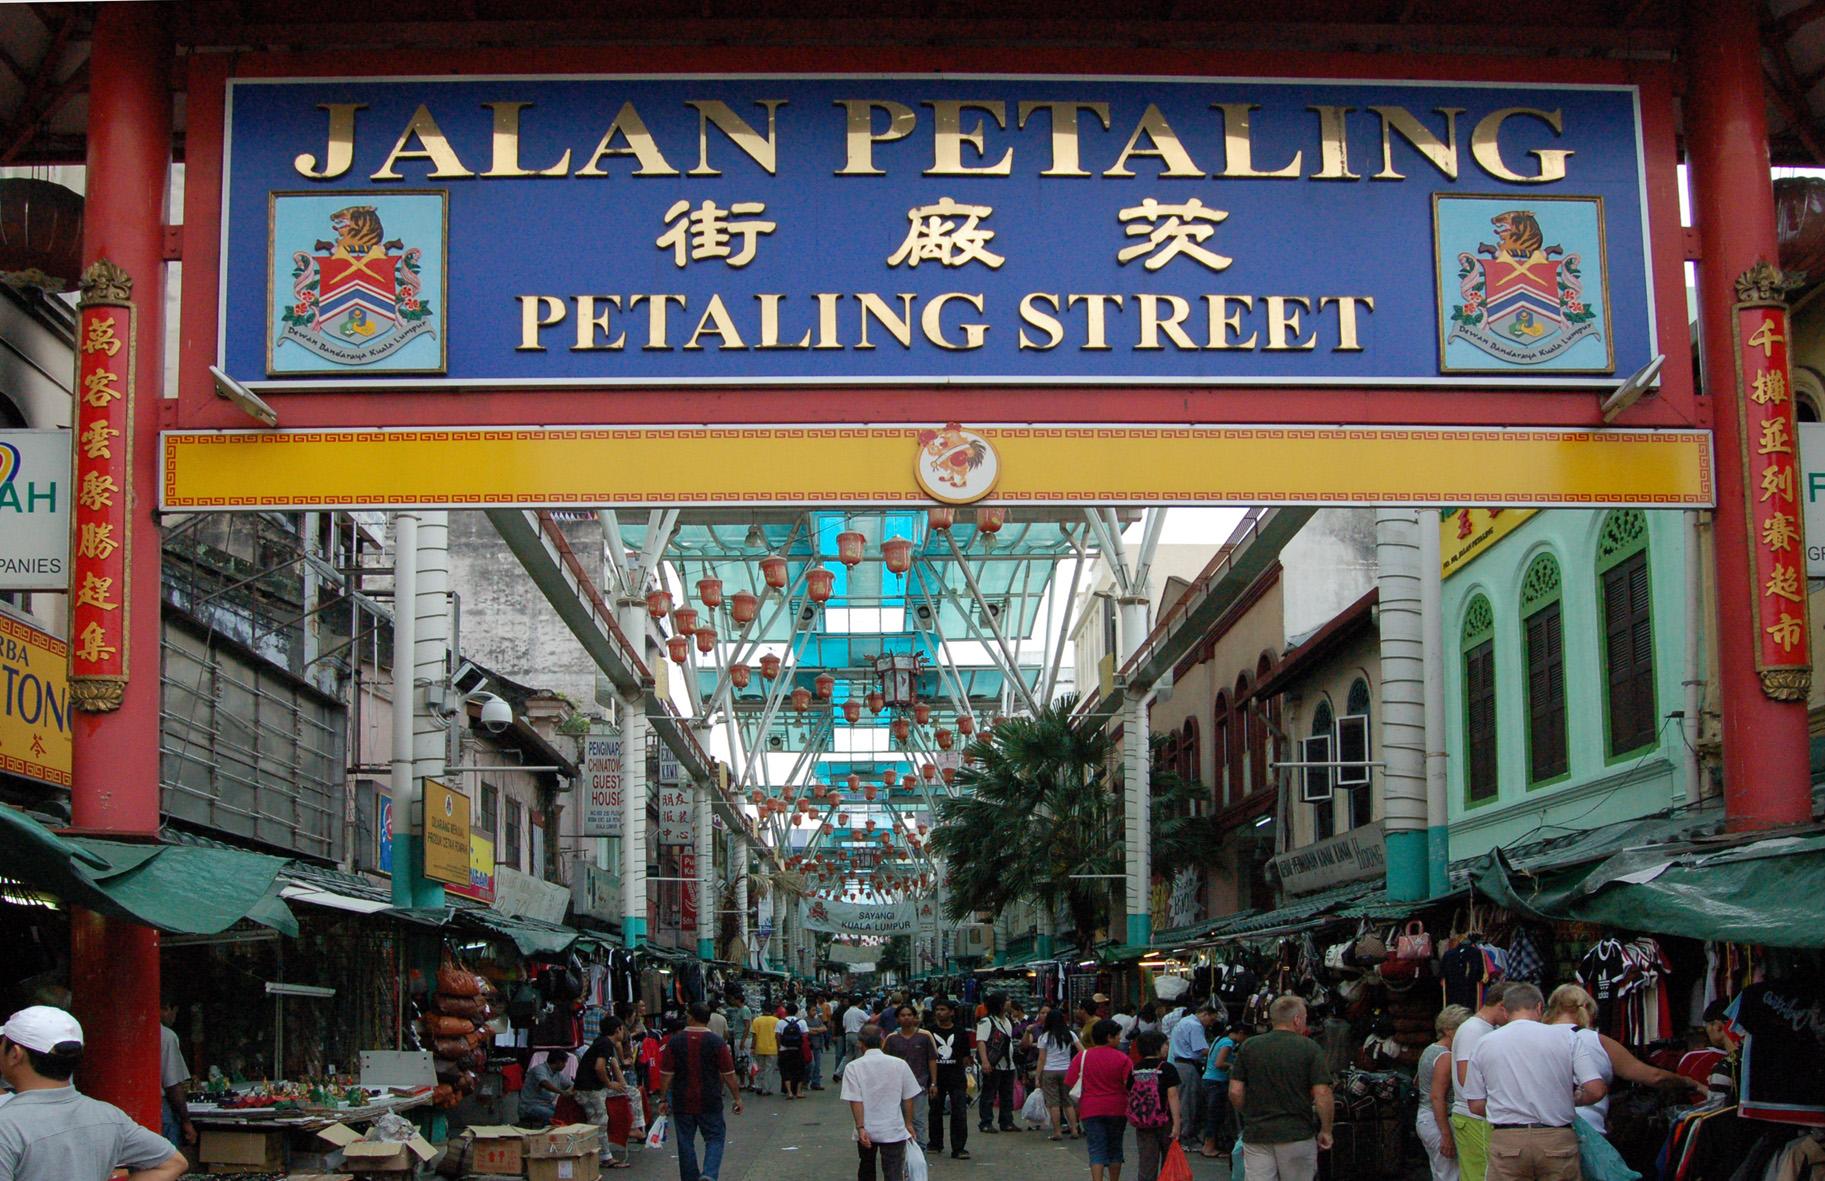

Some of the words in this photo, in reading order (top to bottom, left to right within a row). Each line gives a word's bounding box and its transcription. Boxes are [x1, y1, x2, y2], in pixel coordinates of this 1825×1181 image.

[293, 99, 789, 181] JALAN
[832, 99, 1575, 184] PETALING
[514, 292, 992, 351] PETALING
[1018, 292, 1375, 352] STREET
[841, 920, 872, 932] KUALA
[874, 920, 912, 932] LUMPUR
[858, 911, 895, 921] SAYANGI
